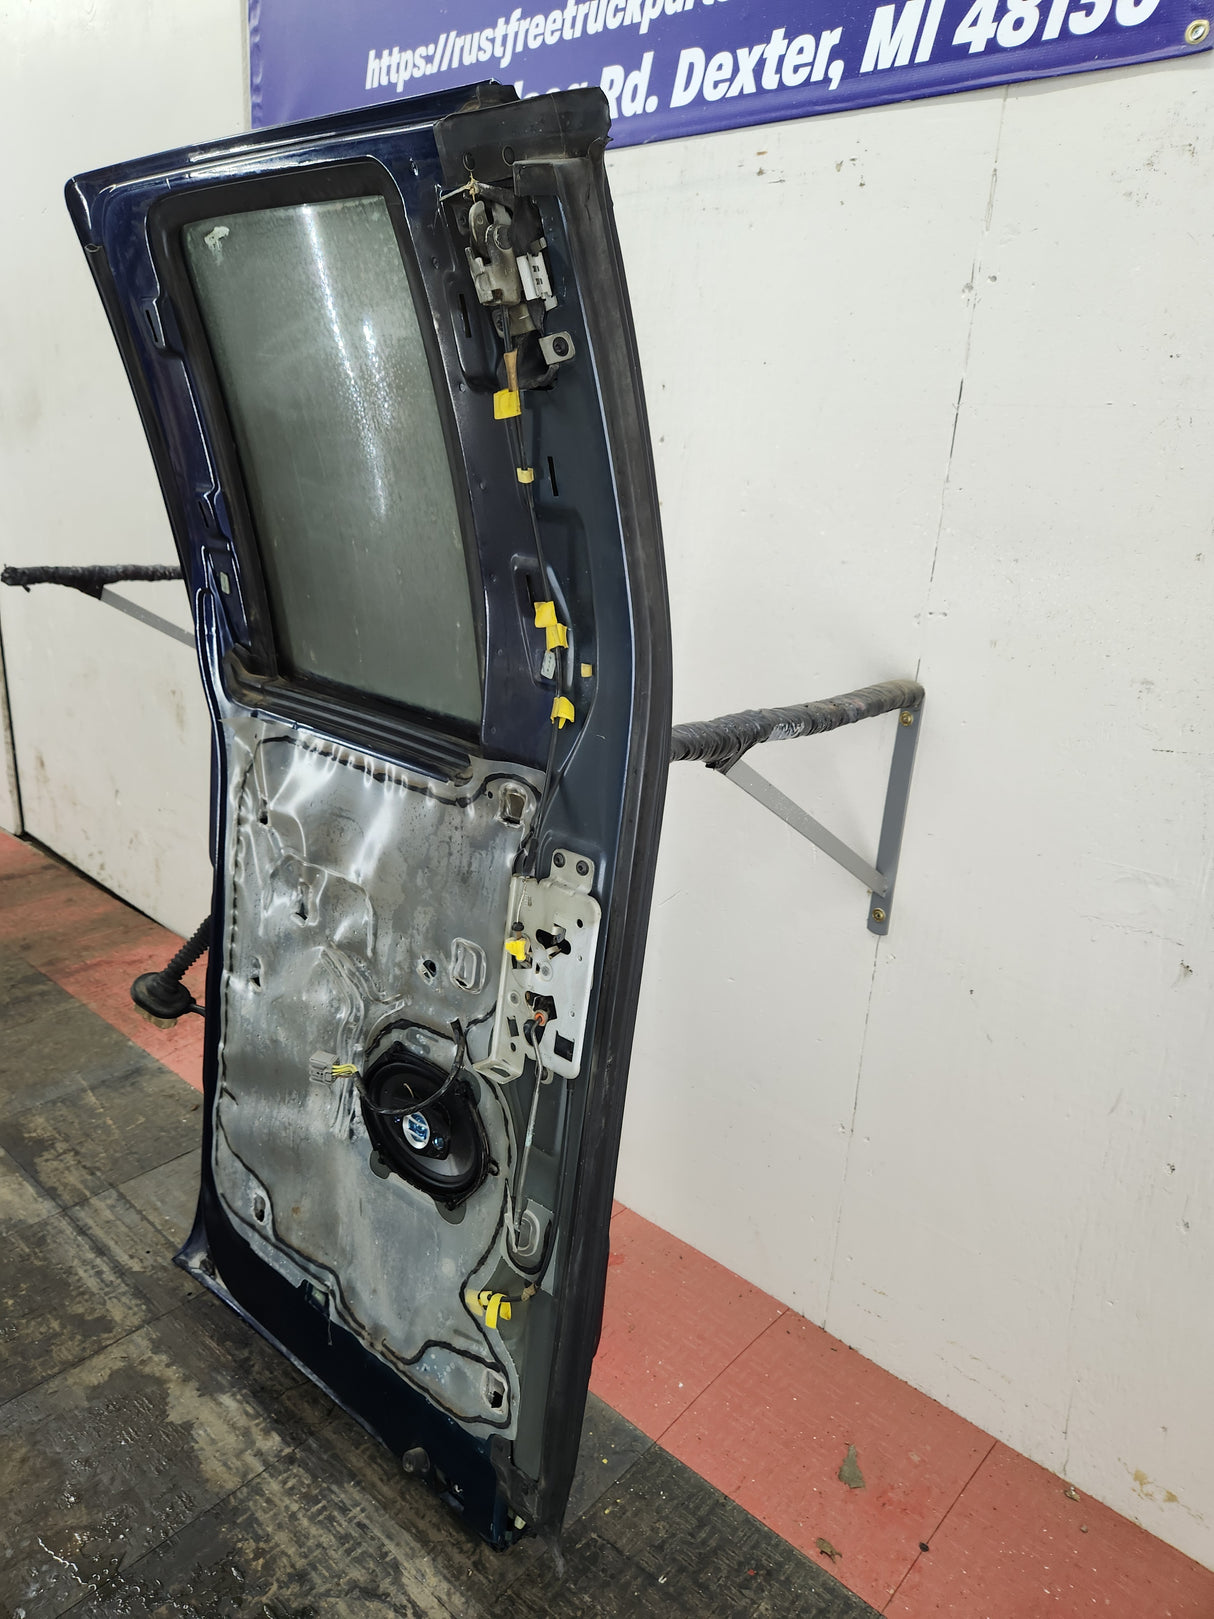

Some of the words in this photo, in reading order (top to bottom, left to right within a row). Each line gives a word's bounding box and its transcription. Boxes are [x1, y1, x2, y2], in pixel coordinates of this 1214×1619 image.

[364, 0, 729, 93] https://rustfreetruckp
[600, 50, 659, 119] Rd.
[670, 26, 845, 108] Dexter,
[859, 0, 947, 74] MI
